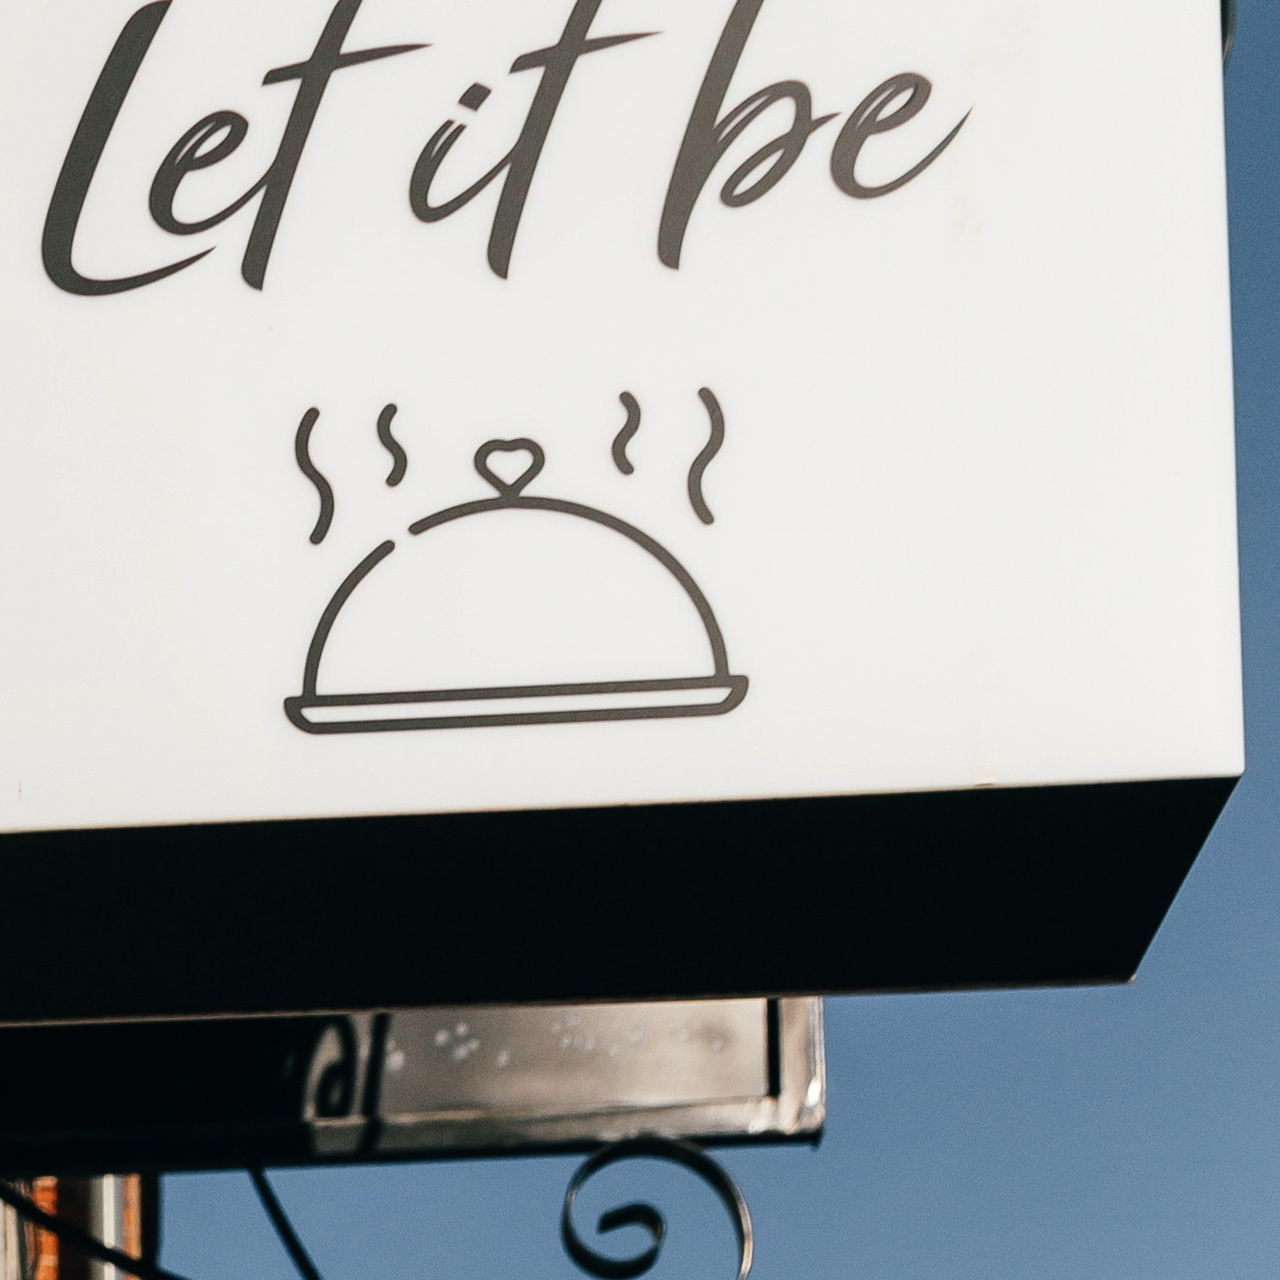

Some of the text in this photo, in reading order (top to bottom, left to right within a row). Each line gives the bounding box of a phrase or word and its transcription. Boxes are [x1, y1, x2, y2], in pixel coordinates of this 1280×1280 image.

[40, 0, 973, 297] Let it be
